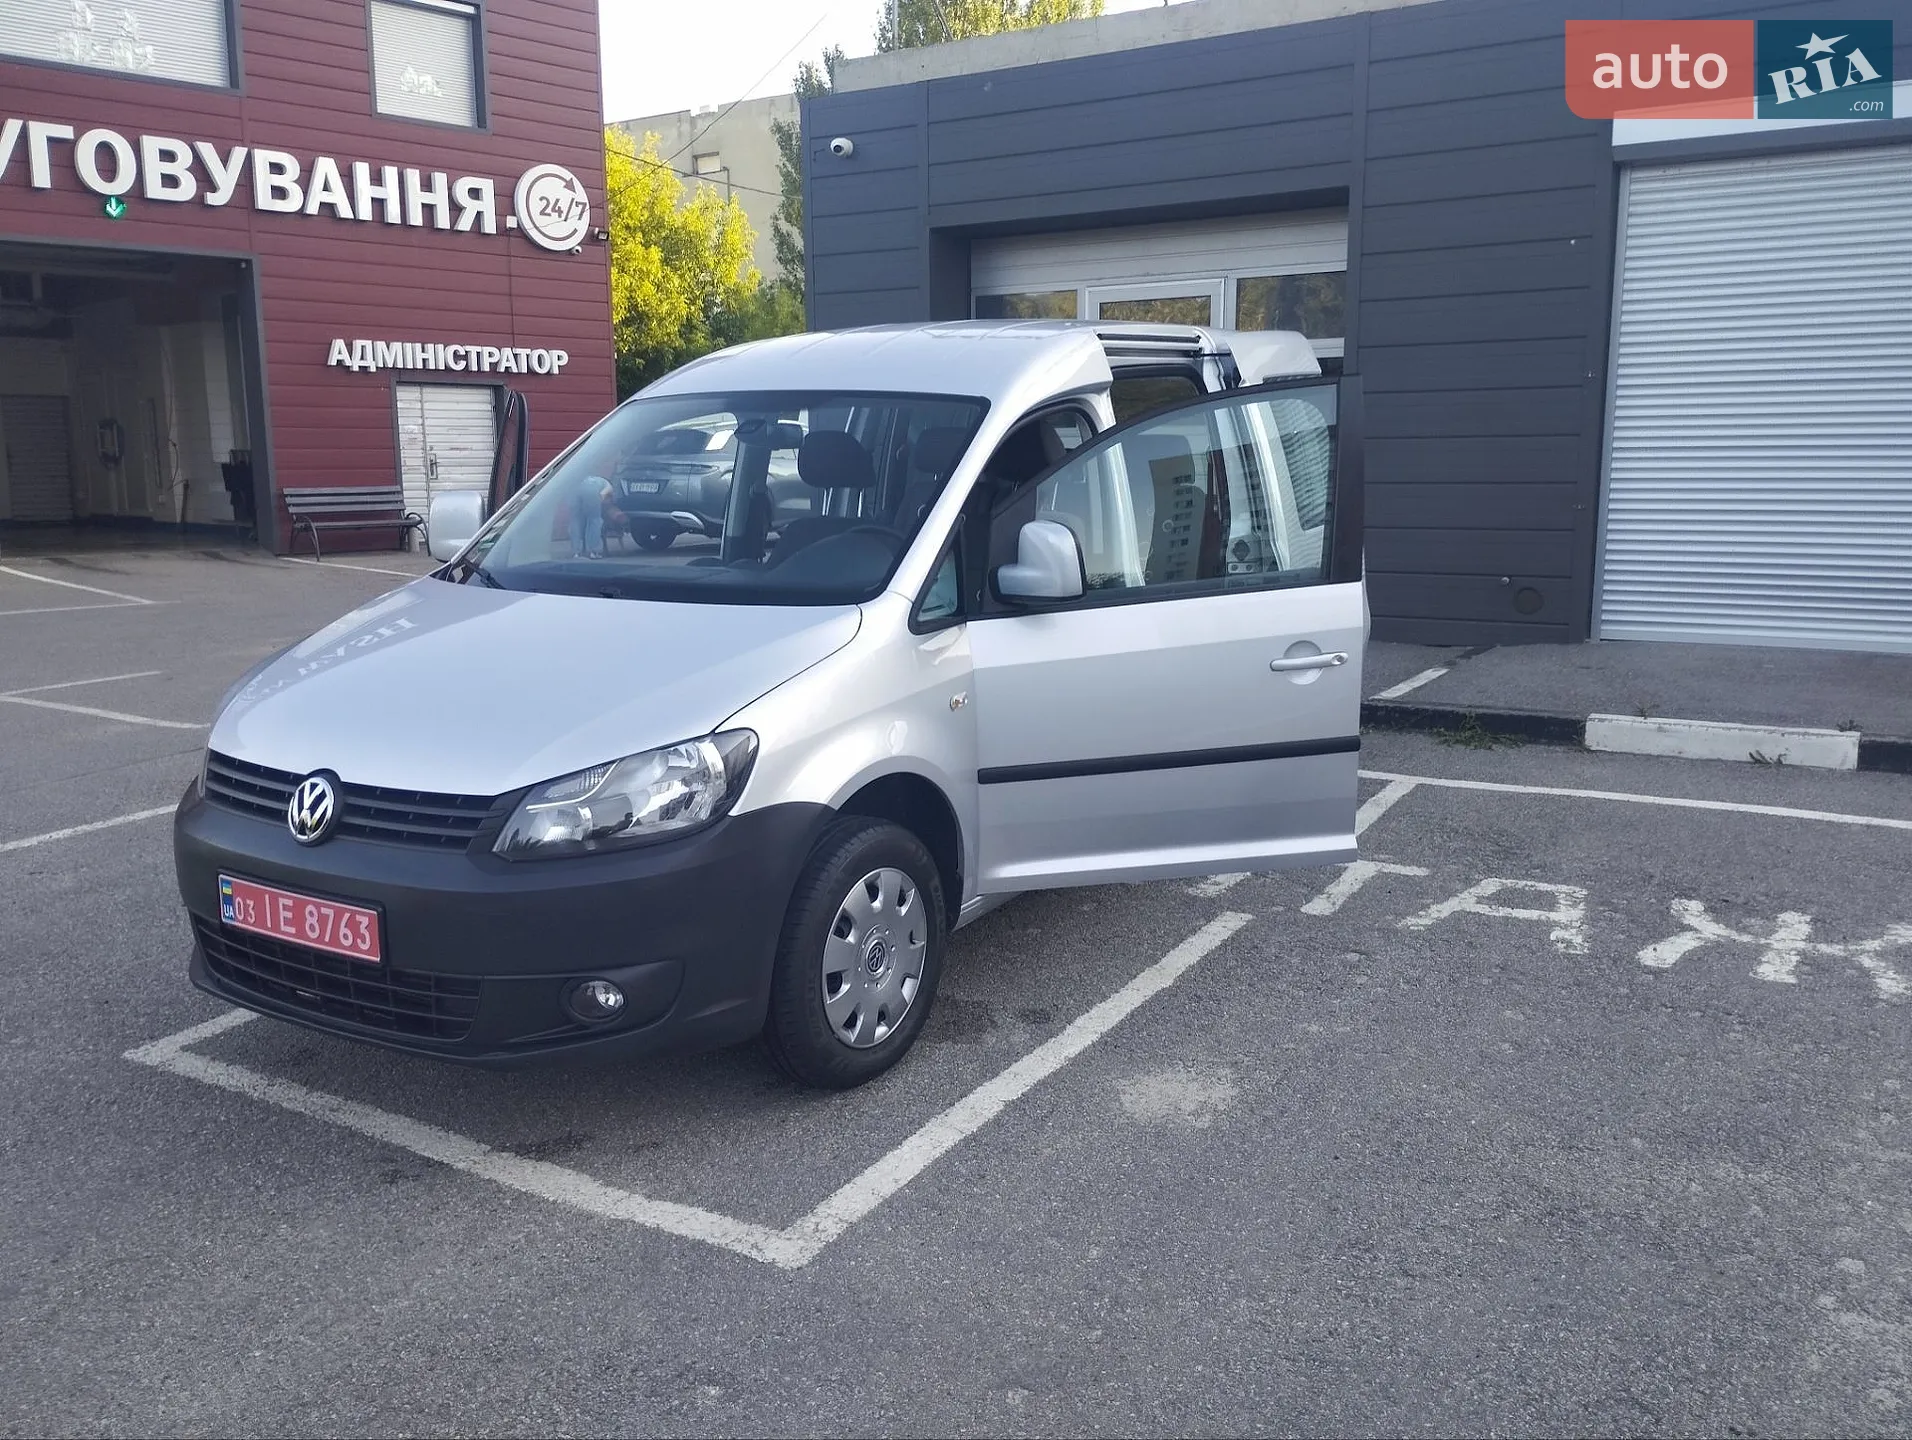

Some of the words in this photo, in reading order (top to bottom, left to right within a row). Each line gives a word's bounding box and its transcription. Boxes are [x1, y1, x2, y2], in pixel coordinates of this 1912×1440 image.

[538, 195, 588, 222] 24/7
[327, 337, 569, 376] АДМІНІСТРАТОР
[223, 903, 235, 918] UA
